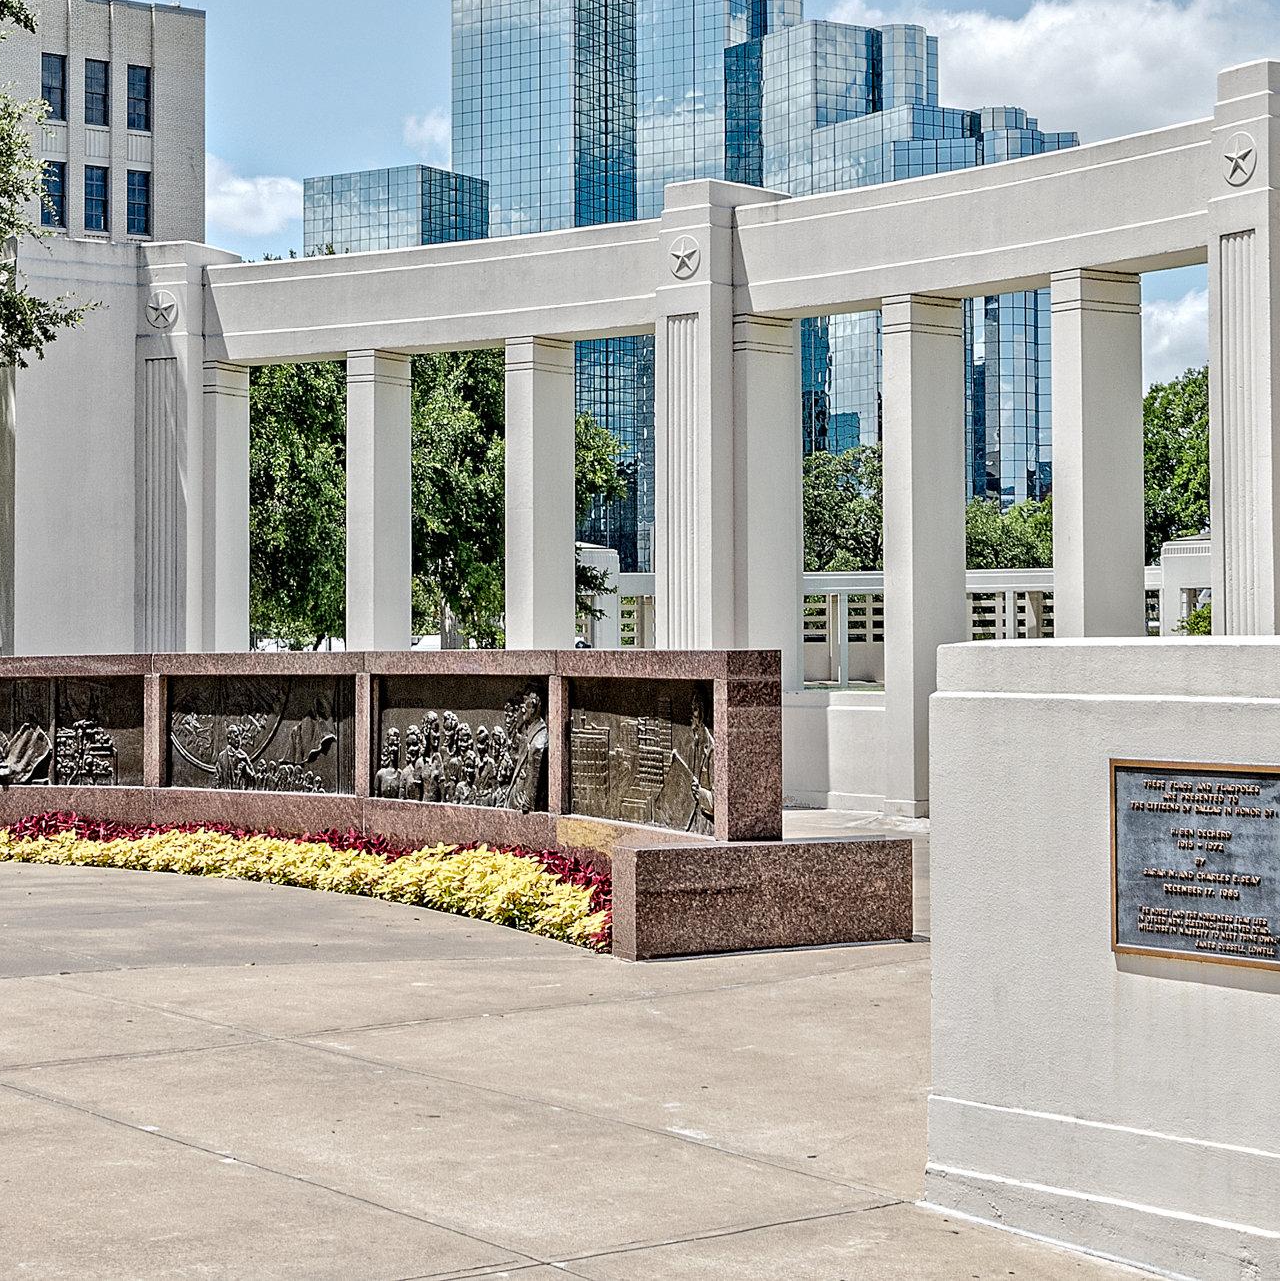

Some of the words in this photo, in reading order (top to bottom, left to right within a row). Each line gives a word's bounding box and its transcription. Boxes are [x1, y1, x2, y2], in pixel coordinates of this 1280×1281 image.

[1143, 779, 1166, 789] THESE
[1196, 782, 1212, 792] AND
[1163, 792, 1177, 801] ARE
[1181, 793, 1224, 804] PRESENTED
[1228, 795, 1239, 804] TO
[1130, 801, 1144, 810] THE
[1147, 802, 1180, 812] CITIZENS
[1182, 804, 1192, 813] OF
[1195, 804, 1222, 815] DALLAS
[1224, 806, 1232, 815] IN
[1194, 857, 1206, 867] BY
[1196, 872, 1230, 884] CHARLES
[1164, 883, 1202, 896] DECEMBER
